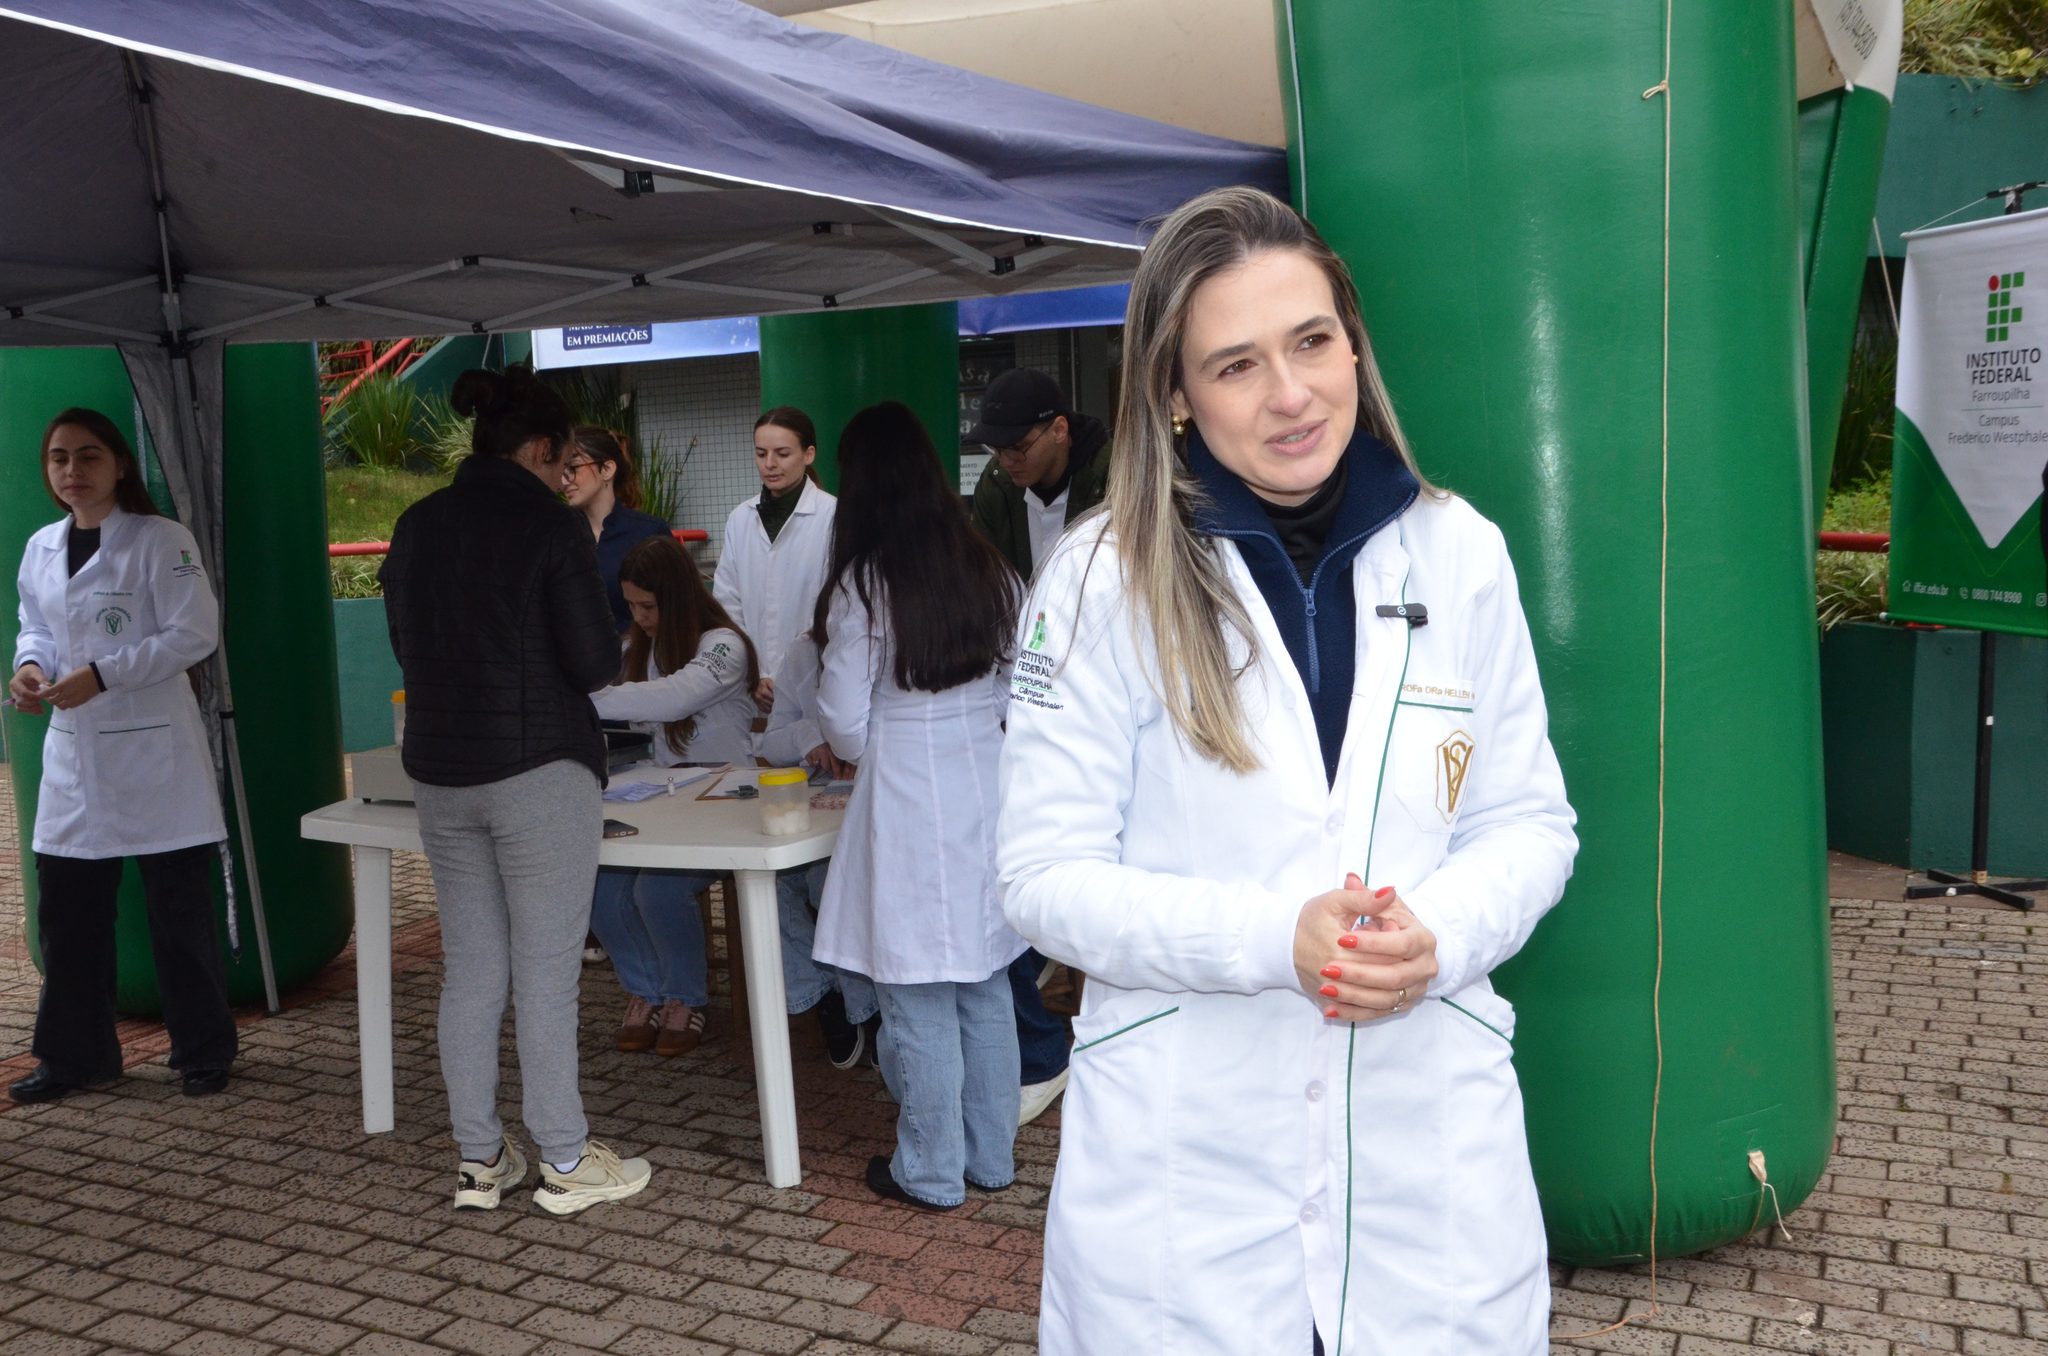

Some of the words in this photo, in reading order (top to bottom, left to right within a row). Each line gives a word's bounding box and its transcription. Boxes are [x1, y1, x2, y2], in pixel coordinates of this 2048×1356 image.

[567, 336, 582, 347] EM
[584, 329, 649, 345] PREMIAÇÕES
[1966, 347, 2042, 369] INSTITUTO
[1972, 366, 2033, 385] FEDERAL
[1972, 387, 2030, 403] Farroupilha
[1978, 414, 2020, 429] Campus
[1947, 430, 1992, 444] Frederico
[1993, 429, 2048, 445] Westphale
[1020, 650, 1054, 667] STITUTO
[1017, 661, 1052, 678] FEDERAL
[1012, 674, 1053, 690] ARROUPILHA
